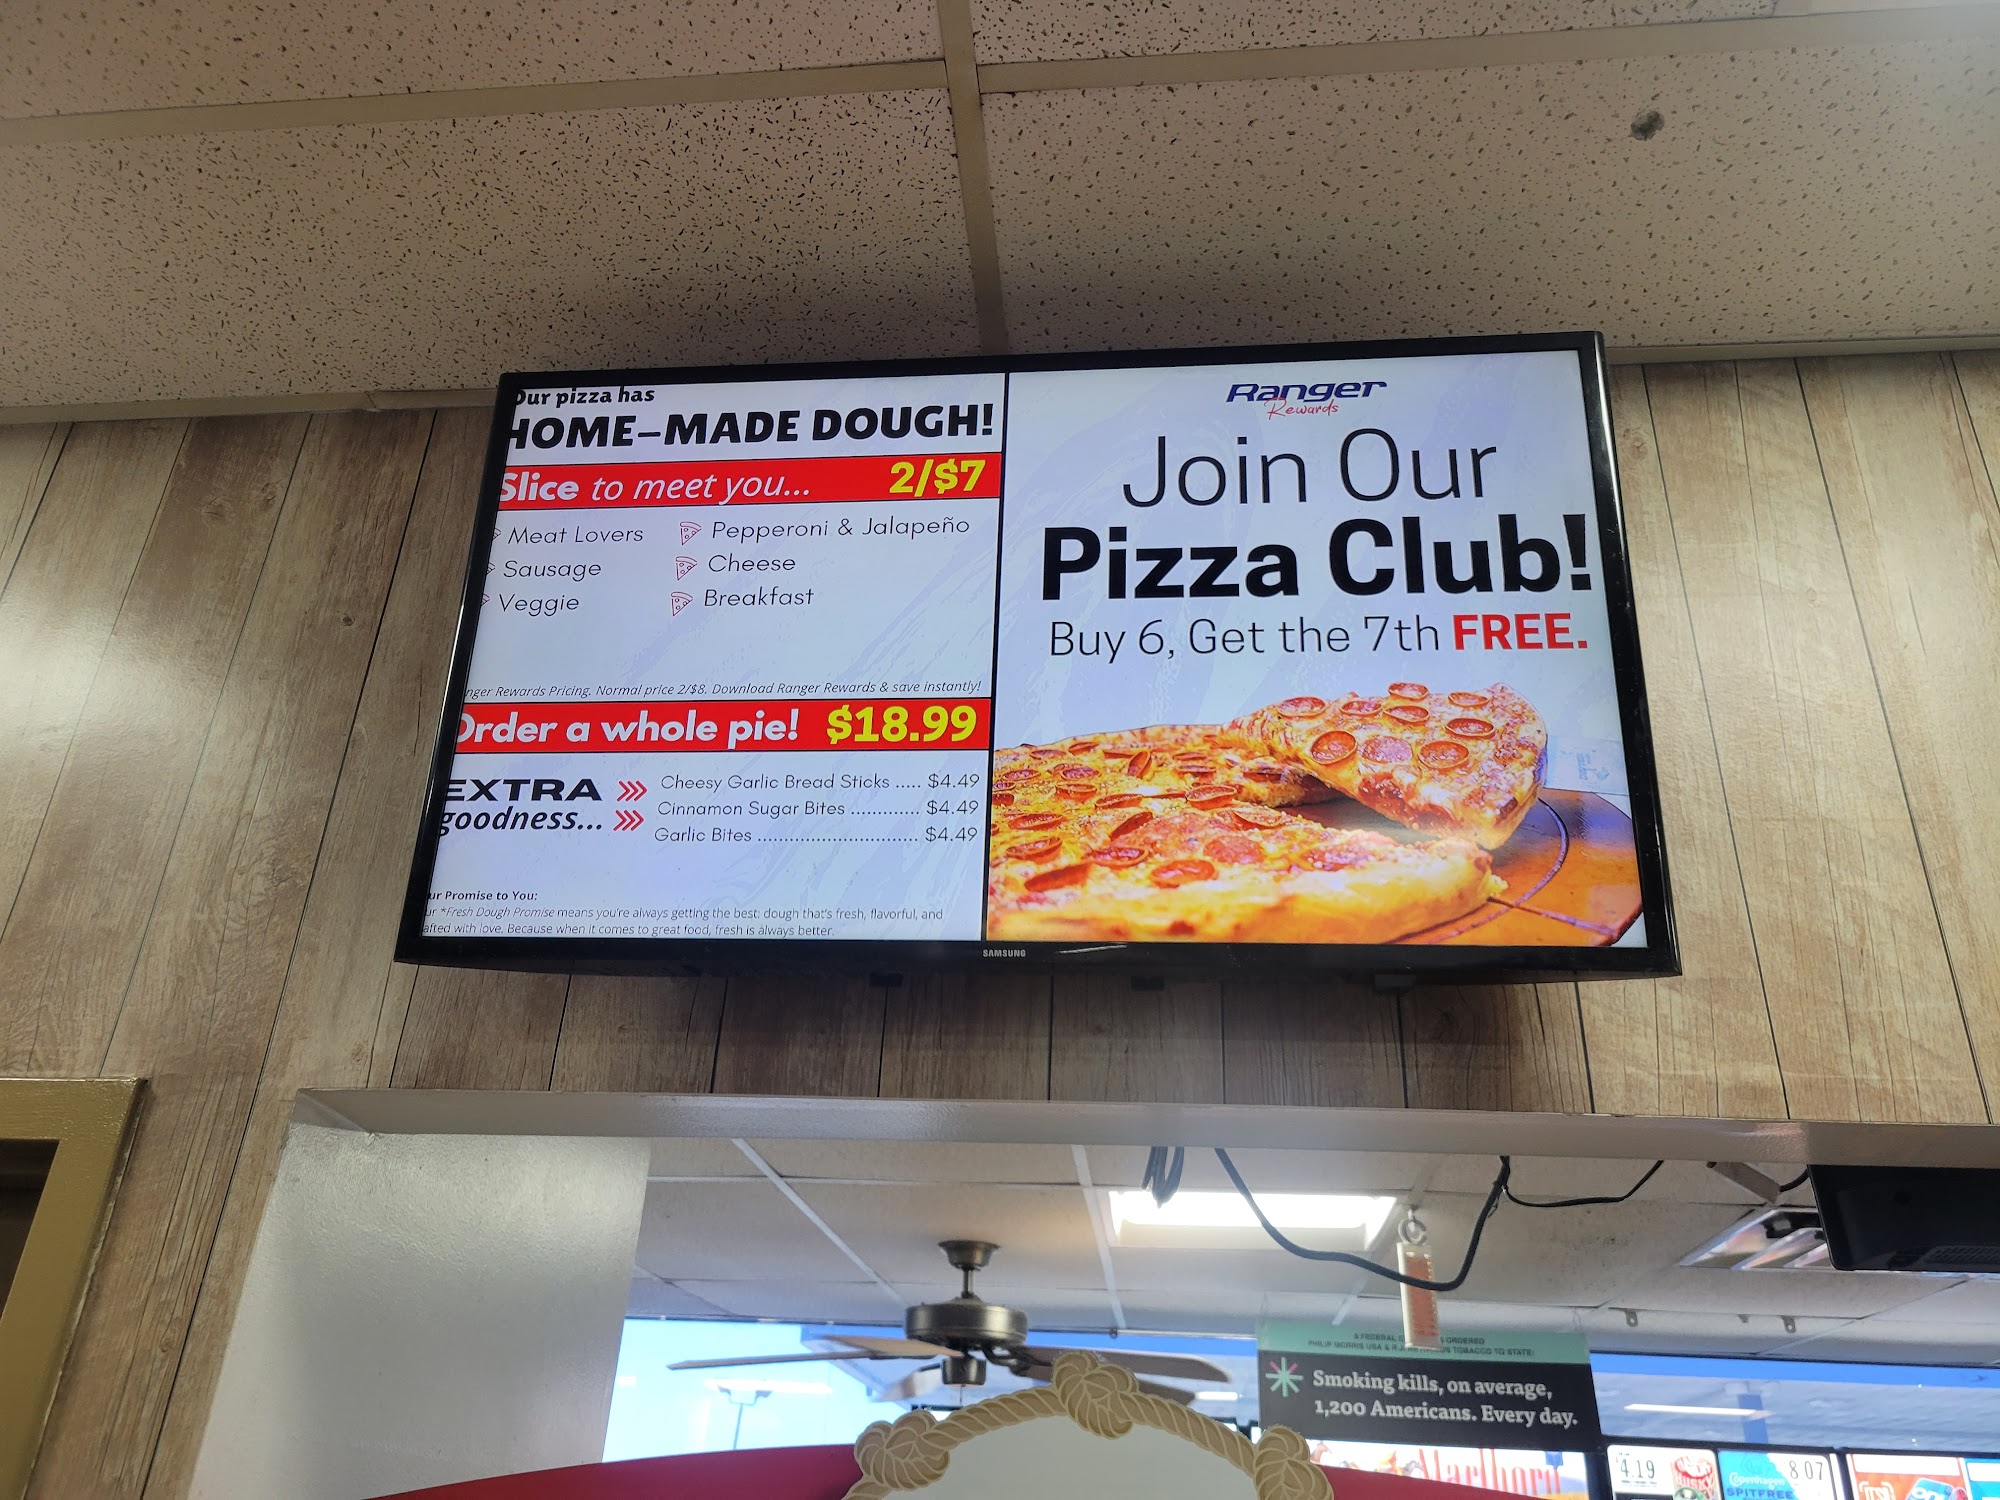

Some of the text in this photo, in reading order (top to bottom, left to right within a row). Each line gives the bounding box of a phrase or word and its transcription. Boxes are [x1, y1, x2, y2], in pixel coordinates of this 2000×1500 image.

[516, 386, 655, 408] Our pizza has
[1226, 381, 1388, 403] Ranger
[1263, 396, 1339, 420] Rewards
[813, 403, 994, 441] DOUGH!
[889, 458, 987, 498] 2/$7
[1122, 428, 1497, 508] Join Our
[500, 471, 811, 505] Slice to meet you...
[507, 525, 644, 545] Meat Lovers
[711, 515, 970, 544] Pepperoni & Jalapeño
[708, 554, 796, 573] Cheese
[1042, 513, 1592, 601] Pizza Club!
[503, 559, 602, 582] Sausage
[499, 594, 580, 617] Veggie
[703, 588, 814, 608] Breakfast
[1050, 612, 1588, 664] Buy 6, Get the 7th FREE.
[465, 681, 982, 700] nger Rewards Pricing. Normal price 2/$8. Download Ranger Rewards & save instantly!
[457, 708, 799, 750] Order a whole pie!
[826, 704, 977, 745] $18.99
[446, 778, 603, 802] EXTRA
[661, 774, 722, 793] Cheesy
[727, 773, 778, 790] Garlic
[784, 773, 835, 789] Bread
[840, 772, 890, 789] Sticks
[927, 772, 980, 789] $4.49
[657, 800, 743, 816] Cinnamon
[749, 800, 799, 820] Sugar
[804, 800, 845, 816] Bites
[926, 800, 979, 816] $4.49
[654, 827, 706, 842] Garlic
[711, 827, 752, 842] Bites
[925, 826, 978, 842] $4.49
[428, 891, 538, 901] ur Promise to You:
[425, 909, 437, 917] ur
[475, 907, 511, 919] Dough
[513, 907, 554, 918] Promise
[557, 909, 594, 918] means
[596, 908, 630, 920] you're
[632, 908, 668, 921] always
[670, 907, 710, 921] getting
[712, 908, 731, 919] the
[763, 908, 799, 922] dough
[802, 908, 833, 919] that's
[836, 908, 867, 920] fresh,
[870, 908, 918, 920] flavorful,
[921, 909, 943, 920] and
[423, 923, 834, 939] afted with love. Because when it comes to great food, fresh is always better.
[983, 949, 1026, 957] SAMSUNG
[1313, 1369, 1553, 1401] Smoking kills, on average,
[1314, 1400, 1578, 1430] 1,200 Americans. Every day.
[1620, 1458, 1656, 1479] 4.19
